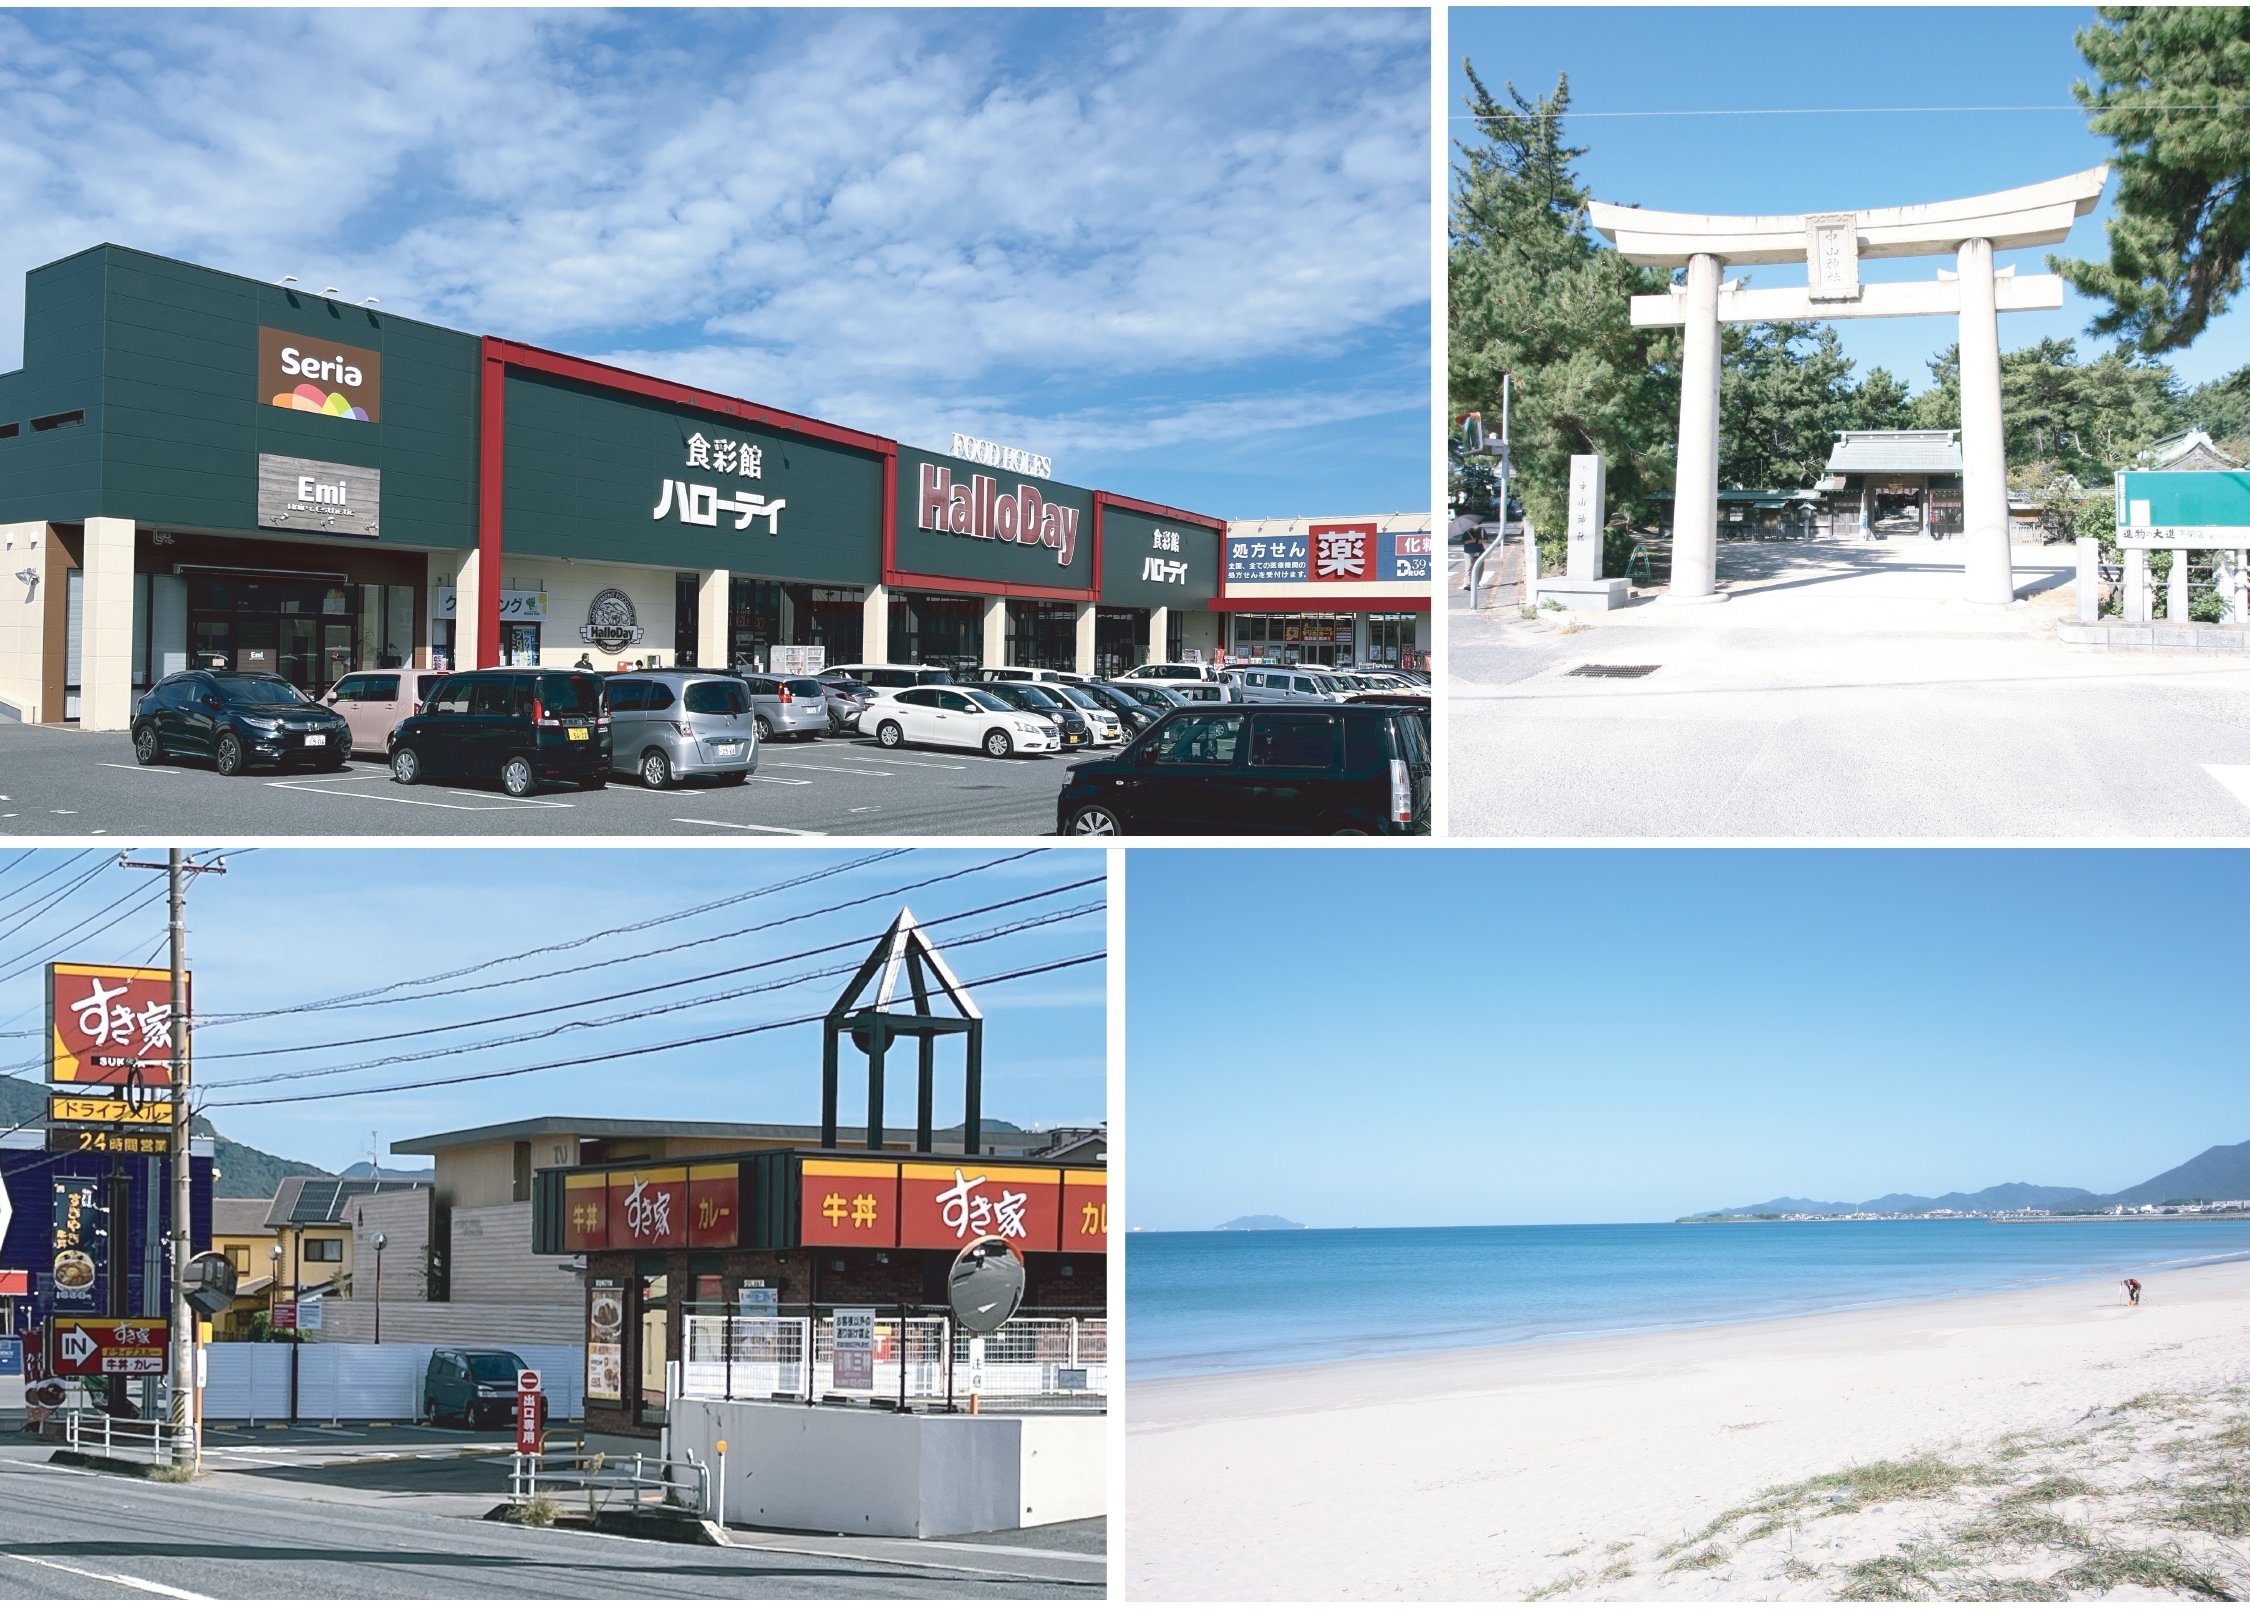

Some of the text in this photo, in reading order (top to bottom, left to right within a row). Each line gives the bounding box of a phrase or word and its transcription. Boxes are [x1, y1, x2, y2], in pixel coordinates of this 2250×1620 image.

[281, 347, 363, 387] Seria
[686, 432, 762, 479] 食彩館
[951, 432, 1000, 468] FOOD
[298, 475, 347, 506] Emi
[653, 479, 786, 535] ハローデイ
[918, 462, 1080, 566] HalloDay
[1152, 528, 1180, 553] 食彩館
[1232, 542, 1306, 559] 処方せん
[1317, 530, 1366, 576] 薬
[1142, 557, 1188, 585] ハローデイ
[1411, 558, 1427, 570] 39
[590, 626, 634, 639] HalloDay
[71, 978, 171, 1056] すき家
[79, 1132, 168, 1152] 24時間営業
[573, 1203, 598, 1233] 牛丼
[624, 1173, 670, 1245] すき家
[698, 1198, 730, 1230] カレー
[822, 1193, 877, 1229] 牛丼
[936, 1169, 1027, 1238] すき家
[65, 1337, 87, 1355] IN
[112, 1321, 151, 1349] すき家
[523, 1394, 536, 1444] 出口専用
